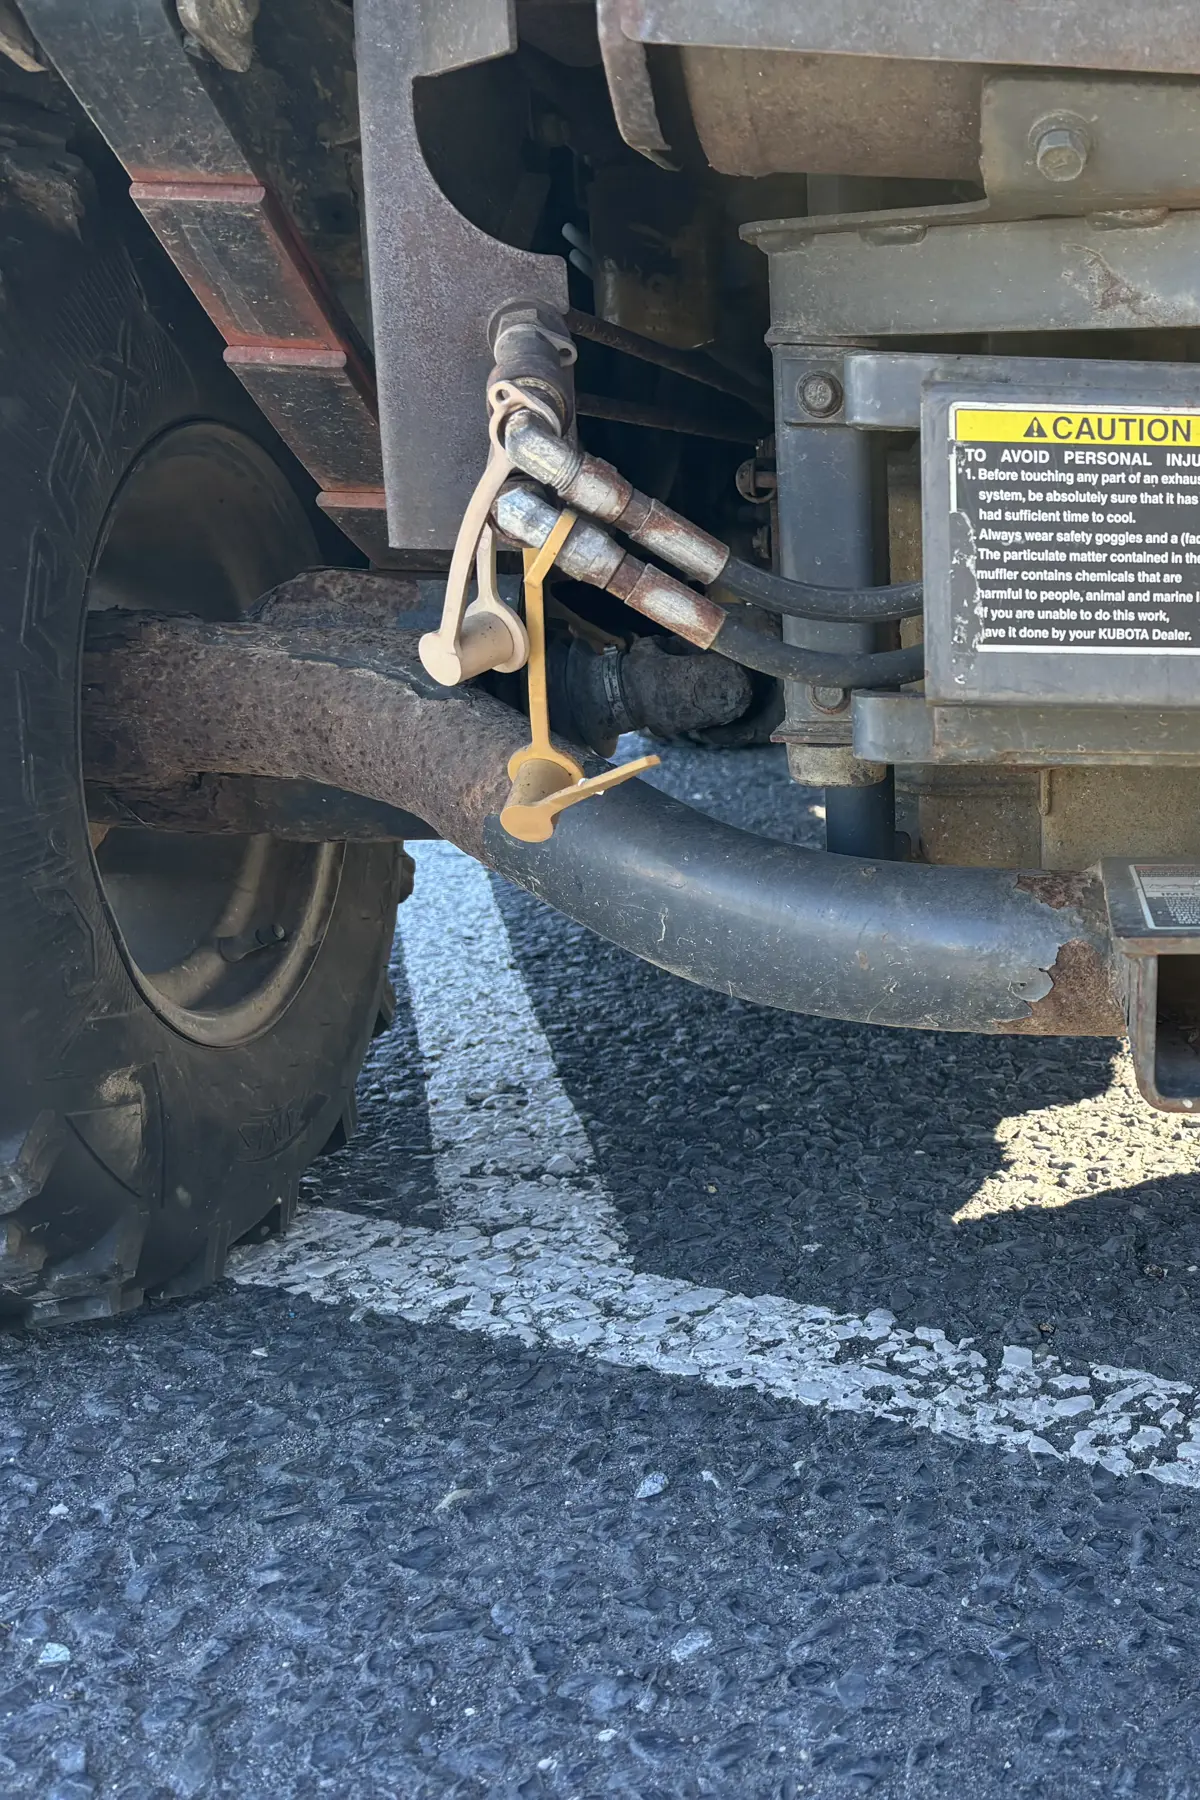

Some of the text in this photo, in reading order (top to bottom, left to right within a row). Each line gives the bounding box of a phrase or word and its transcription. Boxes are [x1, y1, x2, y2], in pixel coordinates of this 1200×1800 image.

[1052, 416, 1191, 442] CAUTION
[965, 448, 986, 462] TO
[1000, 448, 1049, 463] AVOID
[1064, 450, 1152, 466] PERSONAL
[964, 467, 976, 480] 1.
[978, 467, 1018, 481] Before
[1020, 469, 1074, 485] touching
[1076, 472, 1099, 485] any
[1101, 471, 1126, 485] part
[1128, 471, 1141, 483] of
[1143, 474, 1158, 484] an
[978, 489, 1198, 505] system, be absolutely sure that it has
[978, 508, 1136, 523] had sufficient time to cool.
[979, 528, 1023, 544] Always
[1024, 531, 1054, 541] wear
[1056, 529, 1092, 545] safety
[1094, 531, 1143, 546] goggles
[1144, 531, 1168, 543] and
[1170, 534, 1178, 544] a
[977, 547, 1001, 560] The
[1003, 548, 1066, 563] particulate
[1068, 550, 1108, 562] matter
[1109, 551, 1168, 563] contained
[1171, 552, 1182, 563] in
[977, 568, 1182, 583] muffler contains chemicals that are
[1024, 588, 1037, 600] to
[1039, 589, 1083, 603] people,
[1085, 590, 1125, 601] animal
[1127, 591, 1150, 602] and
[1152, 592, 1193, 602] marine
[990, 609, 1012, 621] you
[1014, 609, 1034, 619] are
[1037, 608, 1077, 620] unable
[1079, 608, 1092, 620] to
[1094, 609, 1111, 620] do
[1112, 609, 1135, 621] this
[1137, 610, 1169, 623] work,
[1008, 626, 1016, 637] it
[1018, 626, 1049, 638] done
[1051, 627, 1066, 641] by
[1068, 629, 1096, 641] your
[1098, 628, 1149, 640] KUBOTA
[1152, 629, 1191, 640] Dealer.
